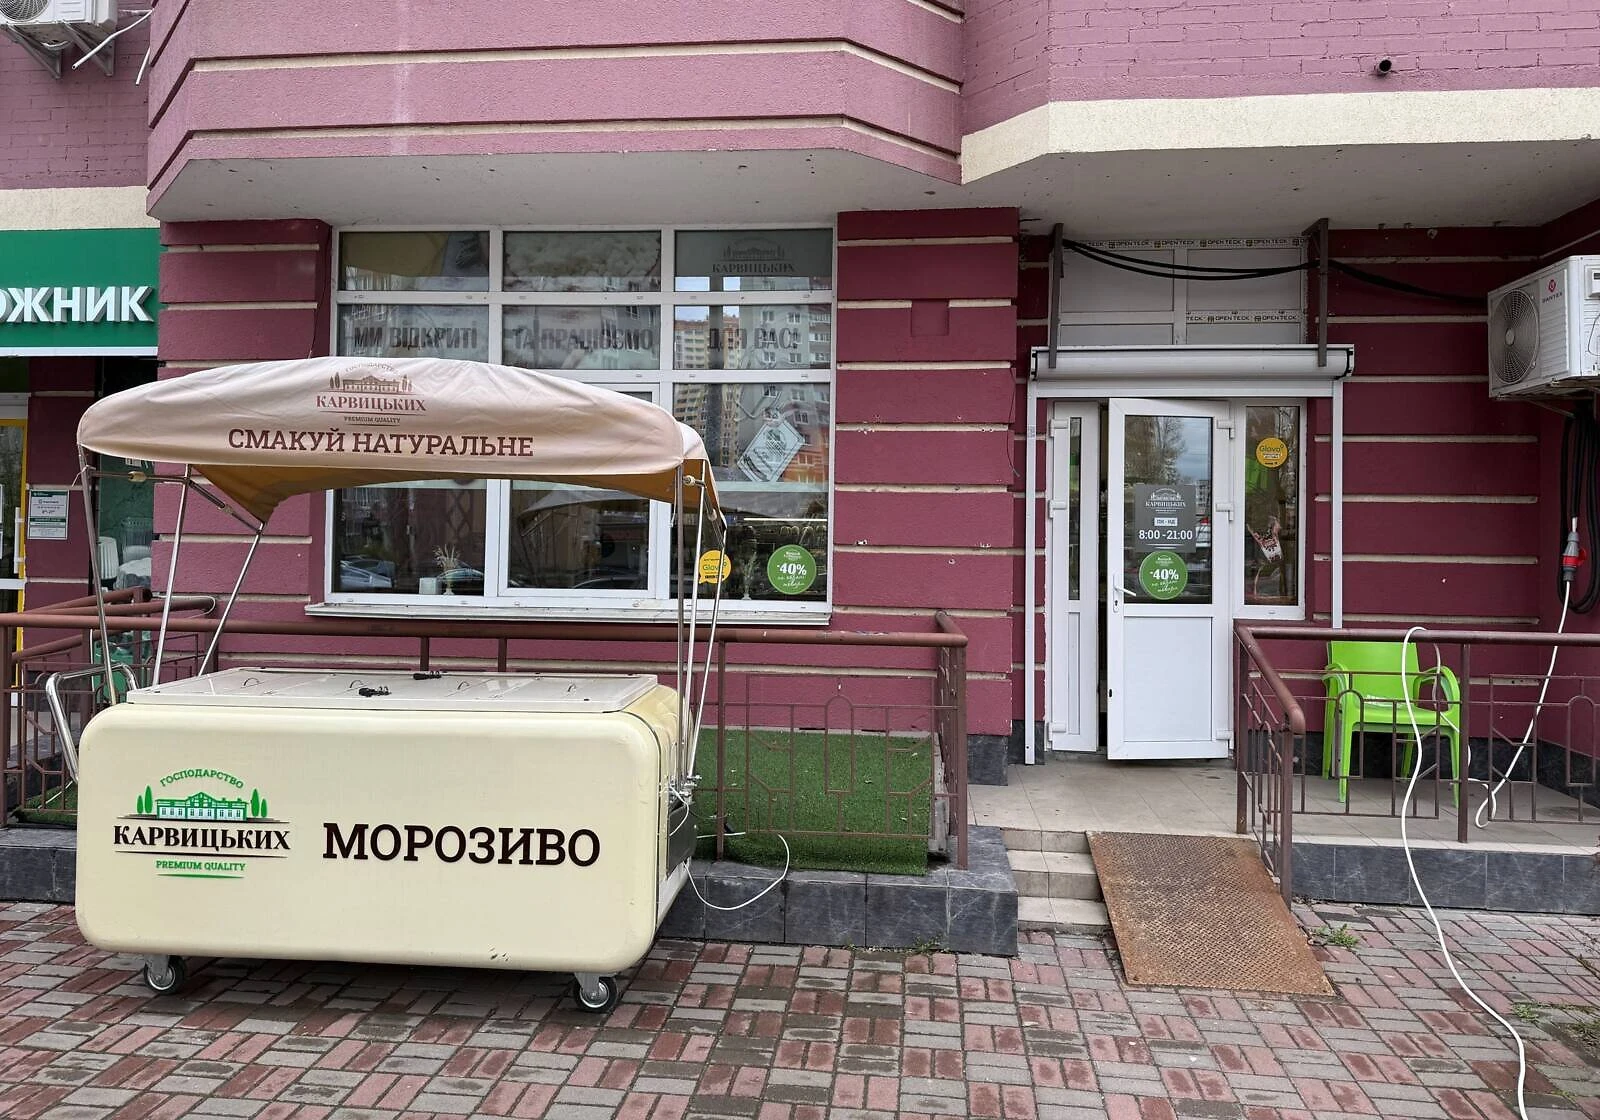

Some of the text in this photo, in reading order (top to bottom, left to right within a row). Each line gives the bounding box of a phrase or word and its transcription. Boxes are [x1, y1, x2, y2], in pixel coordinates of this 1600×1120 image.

[0, 286, 154, 323] ЖНИК
[354, 327, 383, 348] МИ
[390, 321, 478, 350] ВІДКРИТІ
[708, 328, 748, 352] ДЯ
[316, 395, 427, 412] КАРВИЦЬКИХ
[374, 416, 401, 424] QUALITY
[228, 427, 534, 457] СМАКУЙ НАТУРАЛЬНЕ
[776, 563, 807, 575] -40%
[1149, 569, 1179, 580] -40%
[160, 769, 244, 789] ГОСПОДАРСТВО
[113, 825, 291, 851] КАРВИЦЬКИХ
[322, 822, 600, 867] МОРОЗИВО
[156, 860, 246, 871] PREMIUM QUALITY
